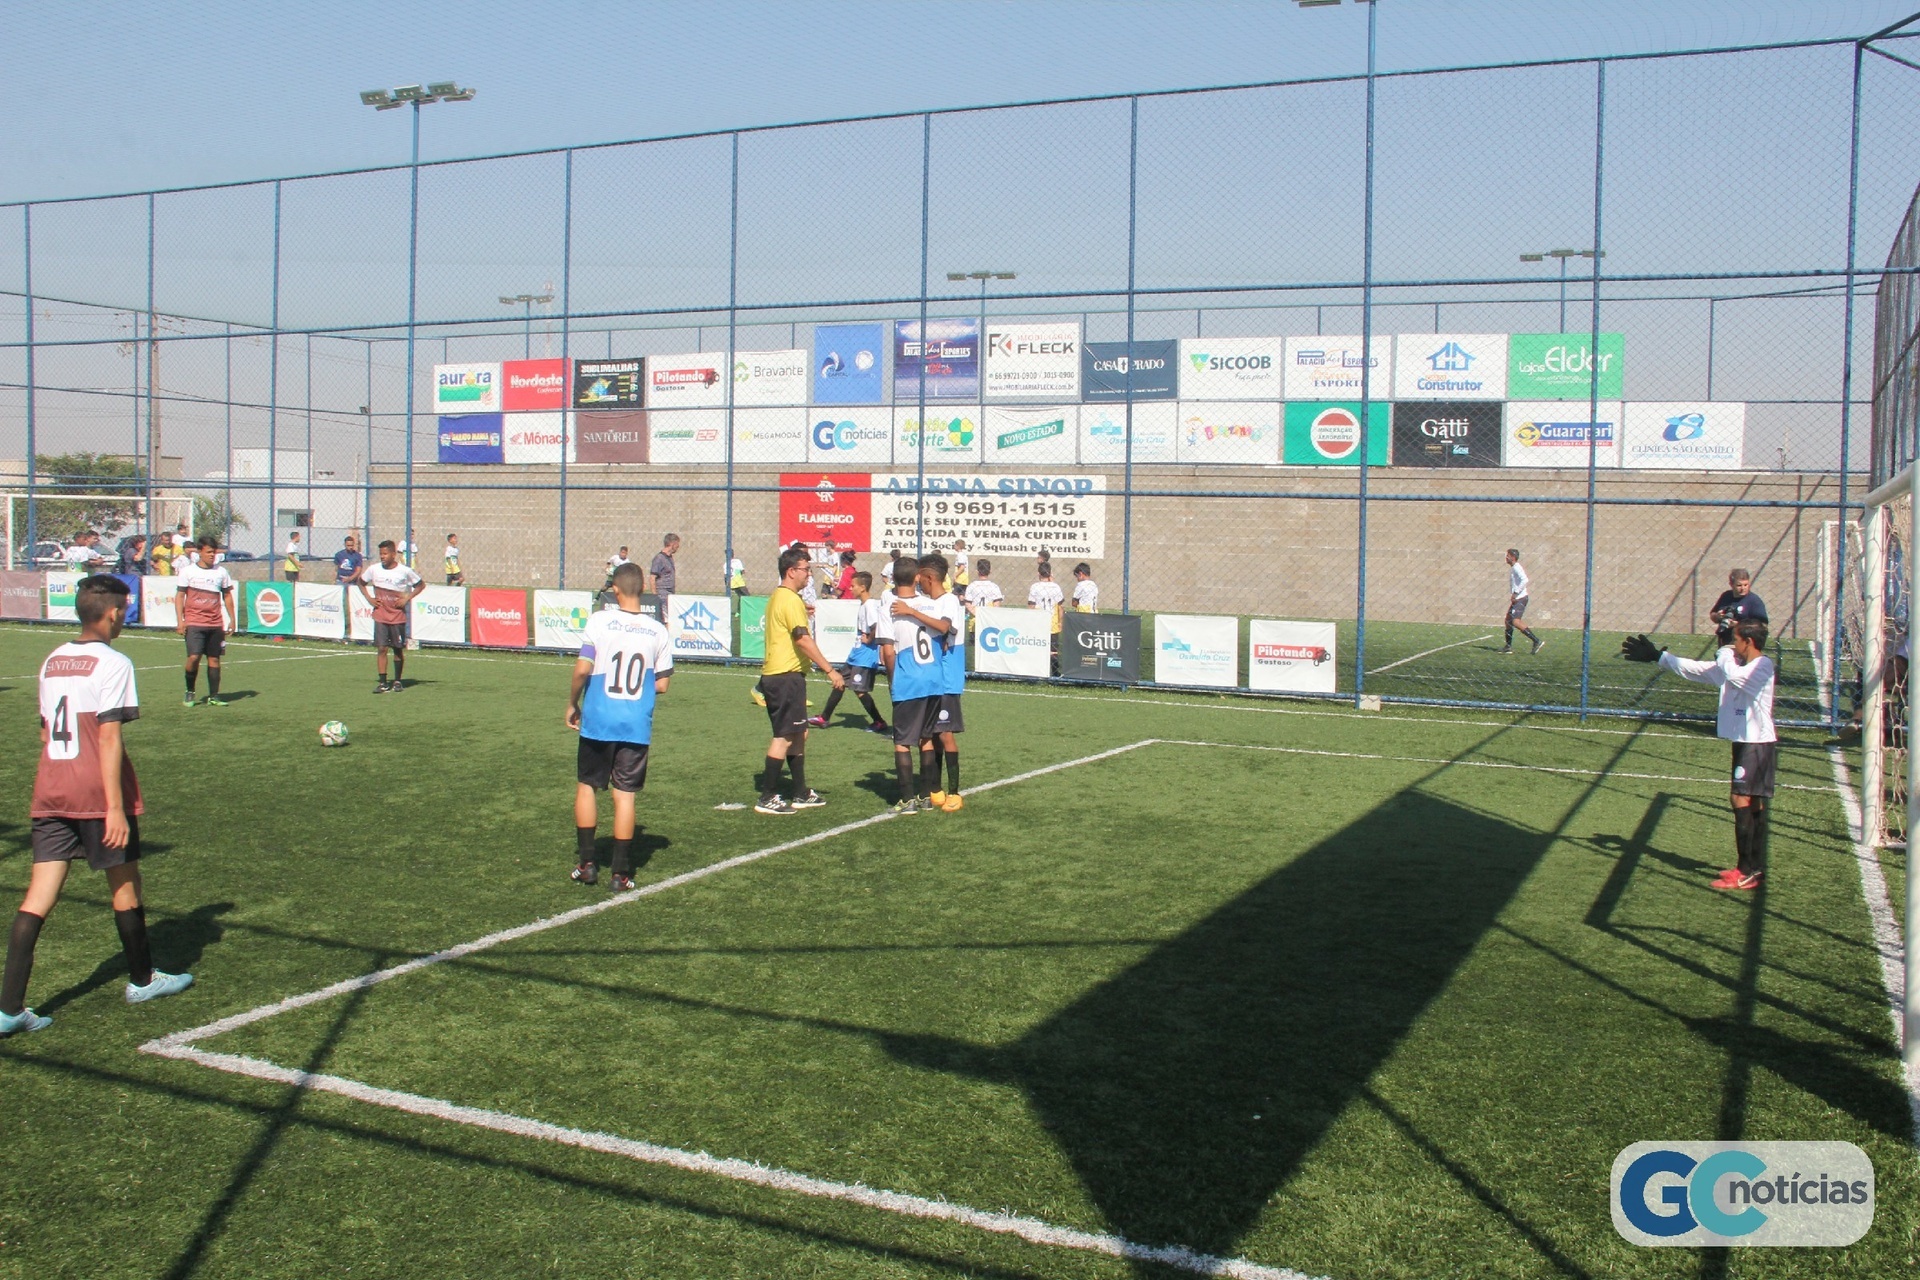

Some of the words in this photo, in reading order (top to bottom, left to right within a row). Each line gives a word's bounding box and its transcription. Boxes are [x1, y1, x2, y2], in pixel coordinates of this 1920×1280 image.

[1017, 342, 1074, 354] FLECK
[1093, 359, 1118, 372] CASA
[1210, 355, 1271, 370] SICOOB
[1519, 361, 1546, 376] Lojas
[1544, 345, 1613, 373] Elder
[439, 371, 492, 385] aurora
[656, 370, 705, 383] Pilotando
[754, 366, 803, 377] Bravante
[510, 373, 564, 388] Nordeste
[1314, 379, 1363, 387] ESPORT
[1417, 377, 1483, 391] Construtor
[523, 431, 571, 445] Mônaco
[909, 432, 945, 447] Srte
[1003, 433, 1026, 446] NOVO
[1541, 424, 1612, 441] Guarapari
[884, 477, 990, 497] ARENA
[997, 478, 1093, 499] SINOP
[897, 501, 931, 513] (6)
[935, 501, 948, 514] 9
[953, 501, 1076, 516] 9691-1515
[798, 513, 854, 524] FLAMENGO
[885, 517, 931, 526] ESCAE
[934, 519, 960, 527] SEU
[964, 519, 1003, 528] TIME,
[1007, 520, 1088, 529] CONVOQUE
[885, 529, 894, 537] A
[898, 529, 957, 538] TOCIDA
[961, 530, 969, 538] E
[973, 531, 1021, 539] VENHA
[1024, 531, 1078, 540] CURTIR
[882, 540, 928, 549] Futebl
[930, 541, 975, 551] Sociy
[983, 543, 1028, 552] Squash
[427, 604, 460, 616] SICOOB
[477, 607, 522, 620] Nordeste
[674, 637, 724, 651] Construtor
[916, 625, 931, 660] 6
[1212, 653, 1231, 662] Cruz
[1257, 645, 1314, 659] Pilotando
[607, 650, 646, 696] 10
[52, 695, 72, 752] 4
